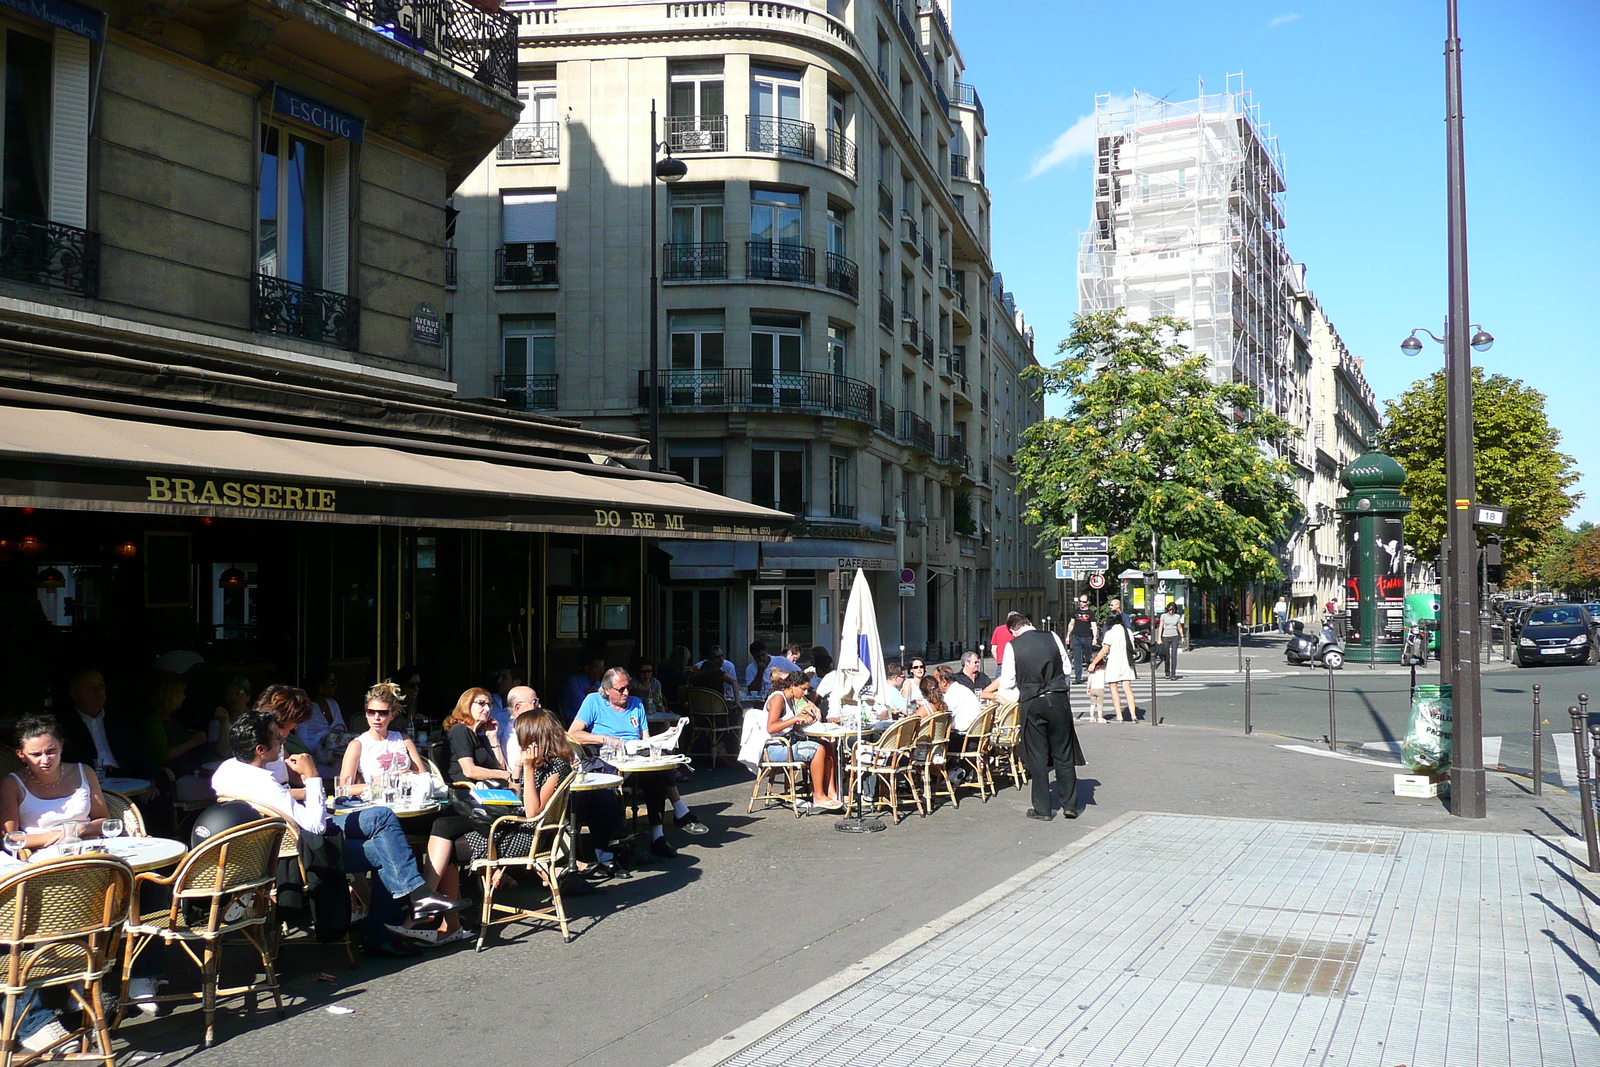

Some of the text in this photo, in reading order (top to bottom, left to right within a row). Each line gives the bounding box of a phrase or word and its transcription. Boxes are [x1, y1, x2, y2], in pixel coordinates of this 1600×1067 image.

[31, 0, 98, 39] Musicales
[290, 97, 350, 138] ESCHIG
[415, 316, 440, 329] AVENUE
[416, 324, 437, 335] HOCHE
[145, 475, 336, 512] BRASSERIE
[594, 509, 686, 531] DO RE MI
[1485, 512, 1496, 521] 18
[751, 527, 758, 535] en
